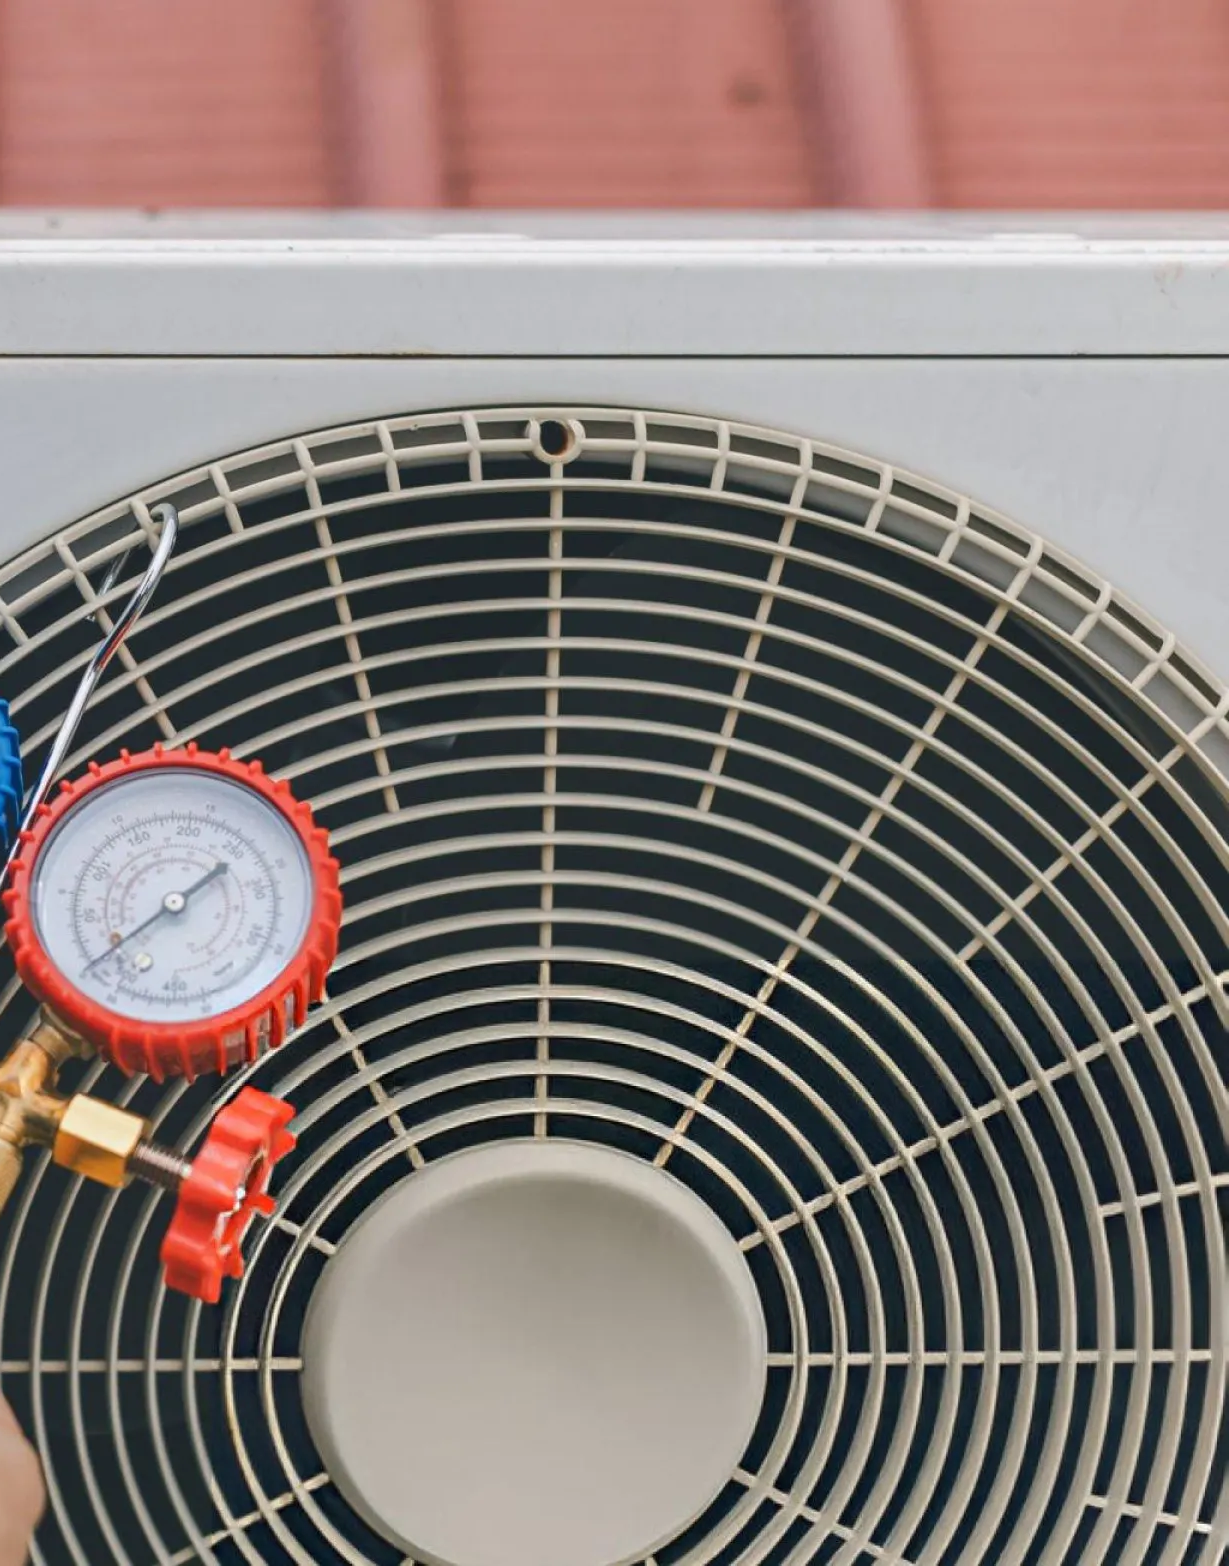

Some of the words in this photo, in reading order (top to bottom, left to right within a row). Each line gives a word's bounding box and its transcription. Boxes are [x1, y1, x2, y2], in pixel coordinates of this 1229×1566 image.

[111, 814, 124, 825] 10
[206, 804, 216, 812] 15
[127, 830, 151, 846] 150
[176, 826, 201, 838] 200
[222, 840, 244, 860] 250
[92, 860, 112, 882] 100
[252, 877, 266, 900] 300
[84, 908, 95, 923] 50
[162, 981, 187, 992] 450
